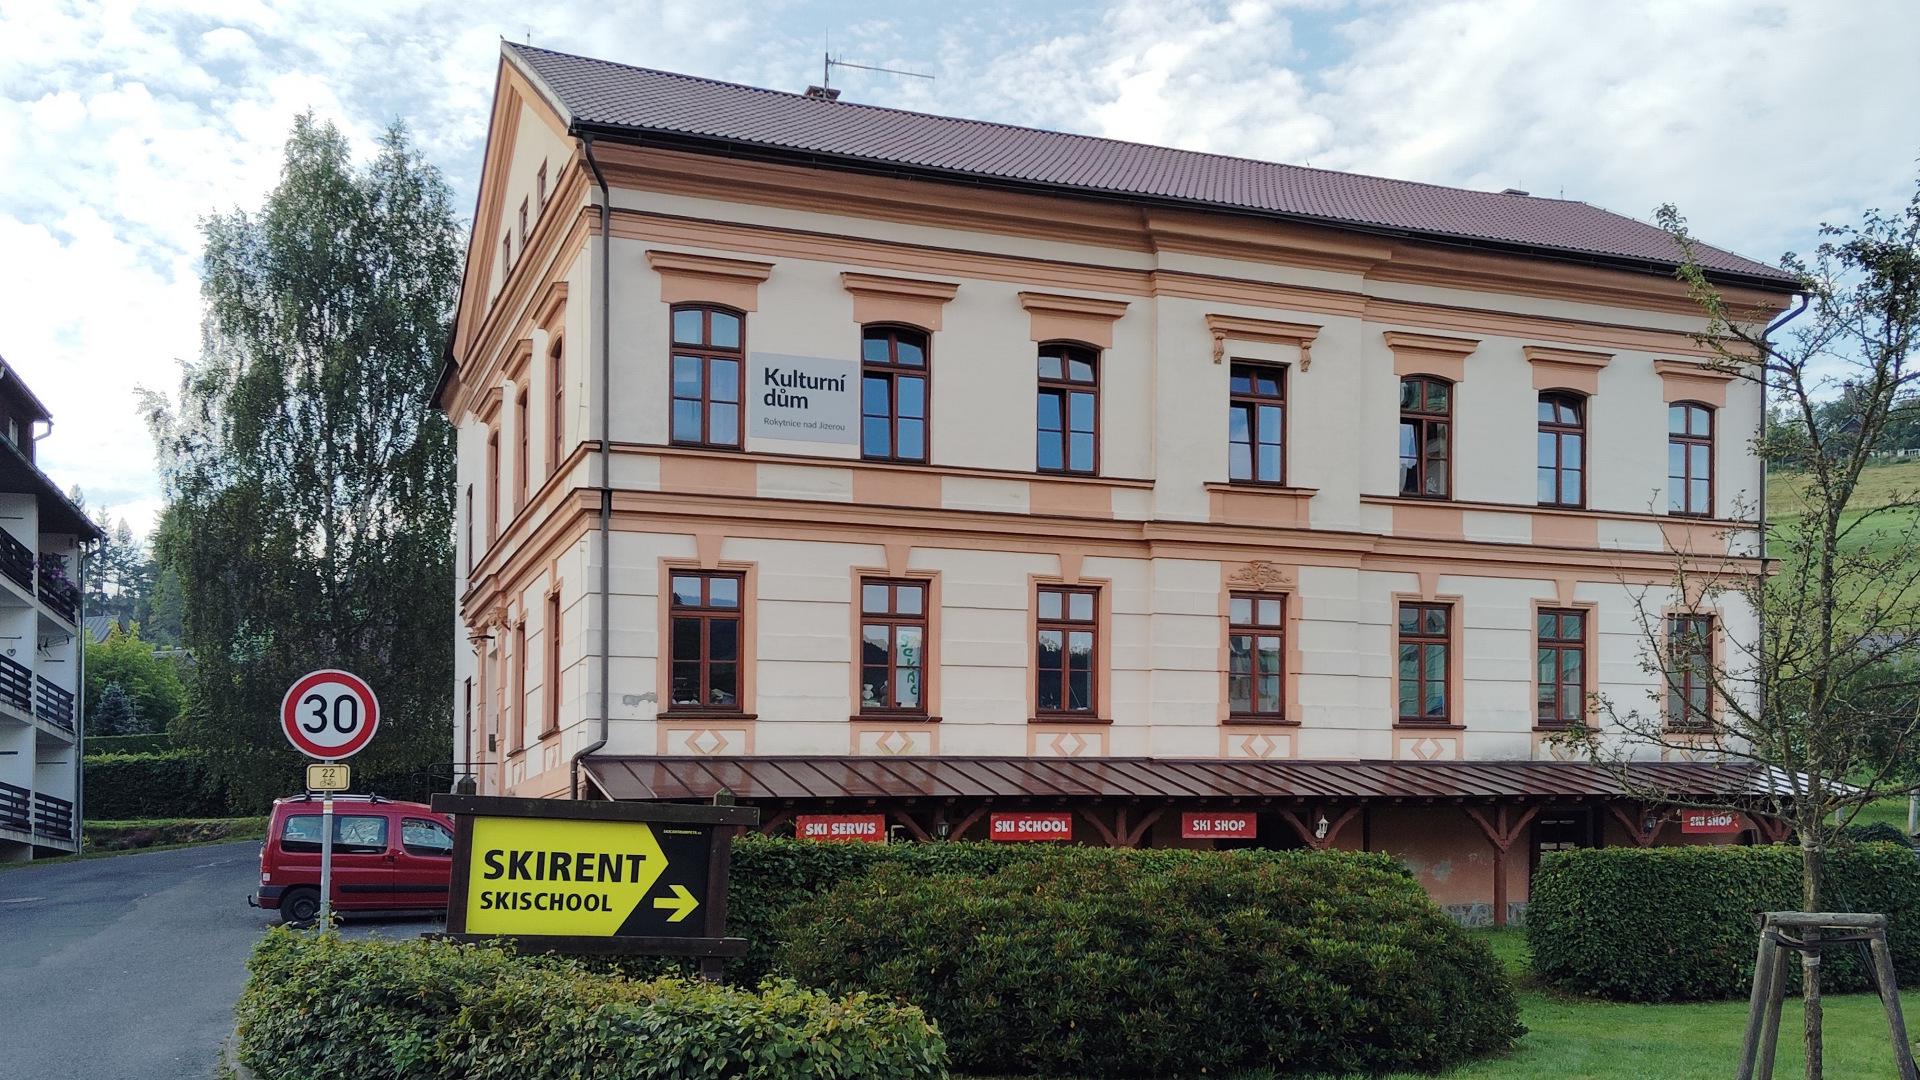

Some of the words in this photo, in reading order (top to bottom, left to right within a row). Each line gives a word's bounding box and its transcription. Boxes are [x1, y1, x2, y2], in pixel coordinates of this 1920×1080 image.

[764, 367, 847, 392] Kulturní
[763, 388, 809, 410] dům
[763, 417, 801, 427] Rokytnice
[803, 421, 817, 429] nad
[819, 421, 846, 431] Jizerou
[303, 694, 358, 734] 30
[322, 768, 336, 778] 22
[995, 820, 1015, 832] SKI
[1018, 820, 1068, 832] SCHOOL
[1192, 820, 1211, 831] SKI
[1214, 820, 1246, 831] SHOP
[1707, 815, 1733, 826] SHOP
[805, 823, 828, 836] SKI
[831, 822, 876, 835] SERVIS
[483, 849, 647, 884] SKIRENT
[480, 891, 613, 912] SKISCHOOL
